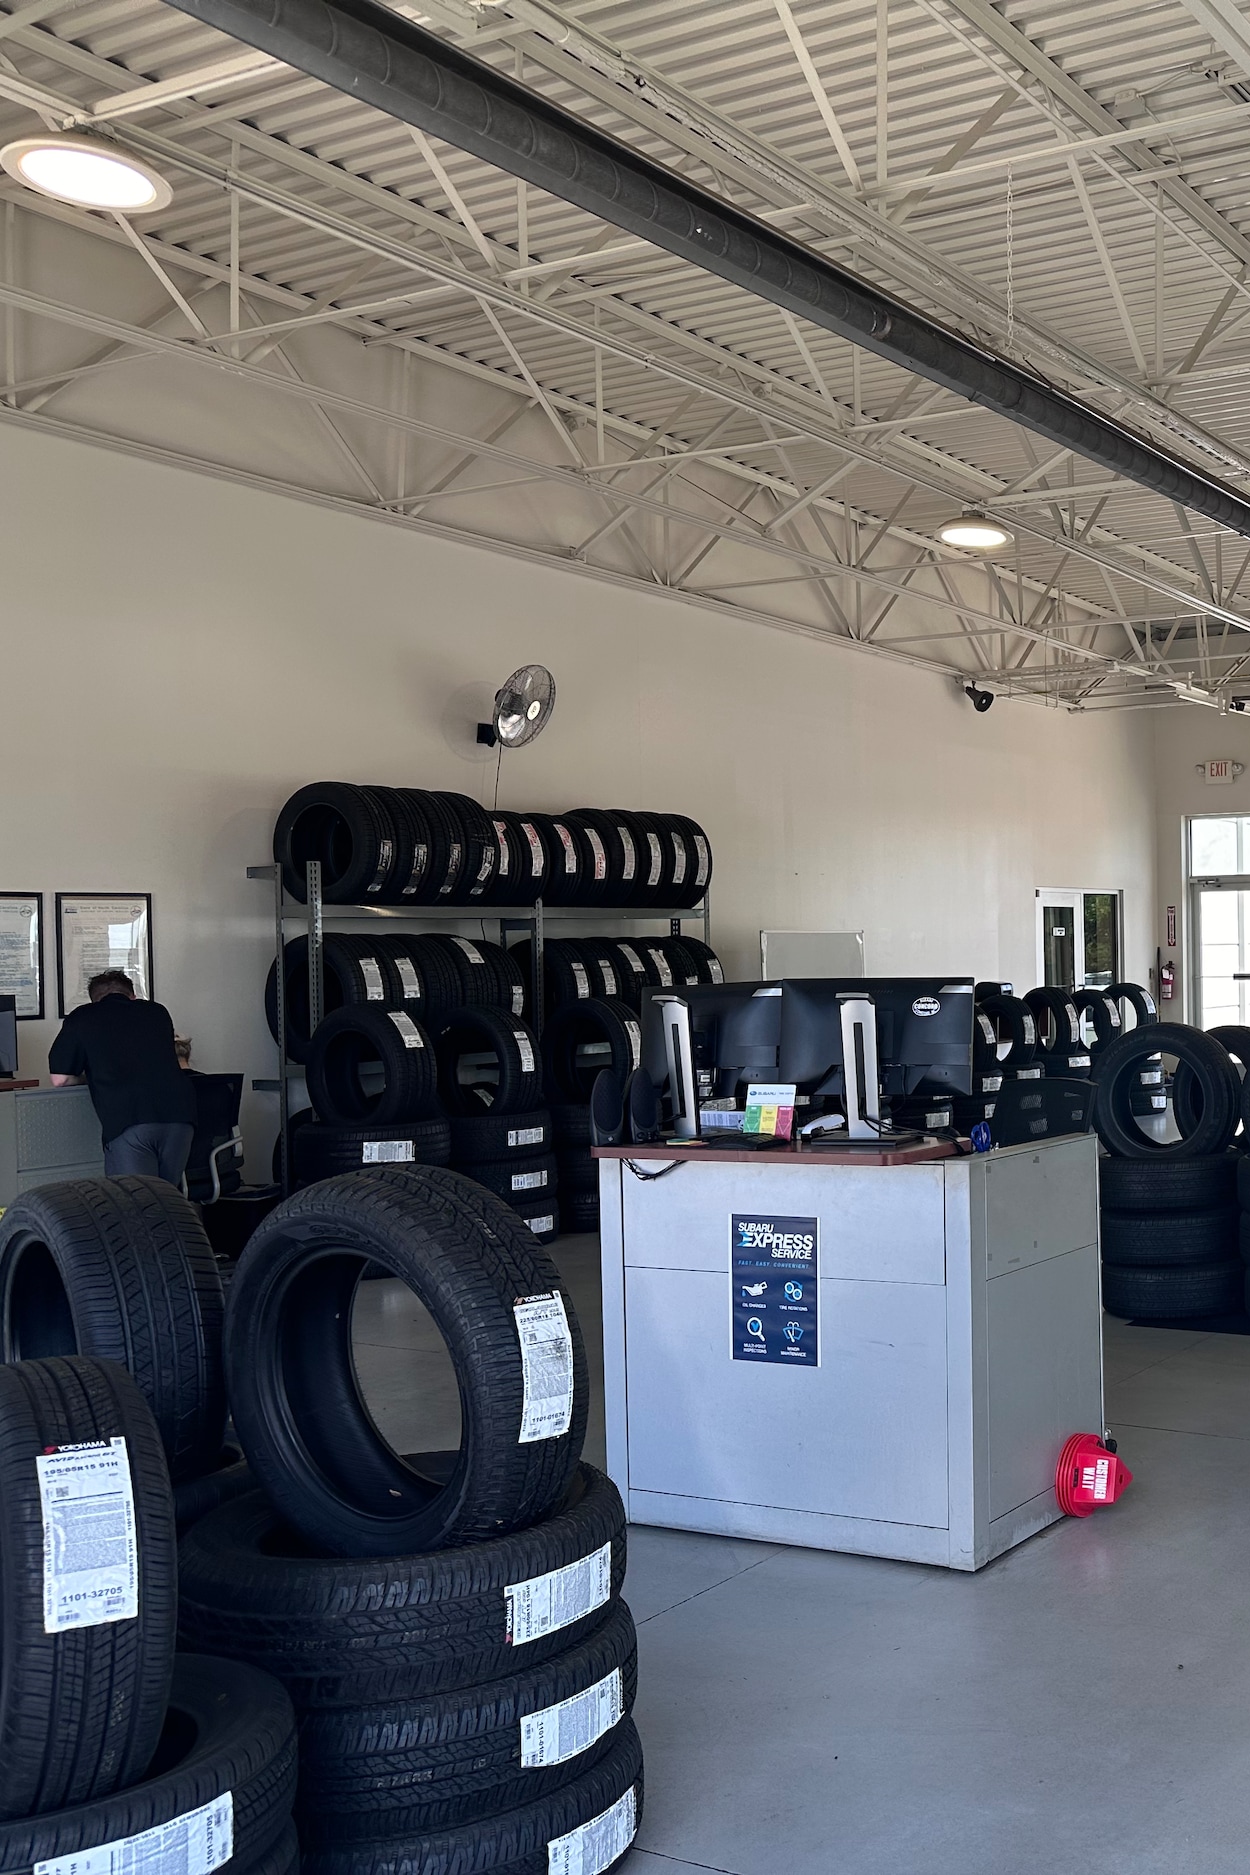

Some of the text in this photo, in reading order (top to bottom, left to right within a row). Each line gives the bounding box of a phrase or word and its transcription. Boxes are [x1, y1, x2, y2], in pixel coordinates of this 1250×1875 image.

[1210, 762, 1228, 777] EXIT
[738, 1222, 774, 1232] SUBARU
[736, 1232, 814, 1250] EXPRESS
[771, 1248, 812, 1260] SERVICE
[523, 1293, 552, 1303] YOKOHAMA
[57, 1441, 107, 1452] YOKOHAMA
[43, 1464, 96, 1476] 195/65R15
[1082, 1467, 1095, 1490] WAIT
[1094, 1459, 1109, 1499] CUSTOMER
[62, 1586, 123, 1603] 1101-32705
[505, 1598, 513, 1634] YOKOHAMA
[206, 1814, 214, 1866] 1101-32705
